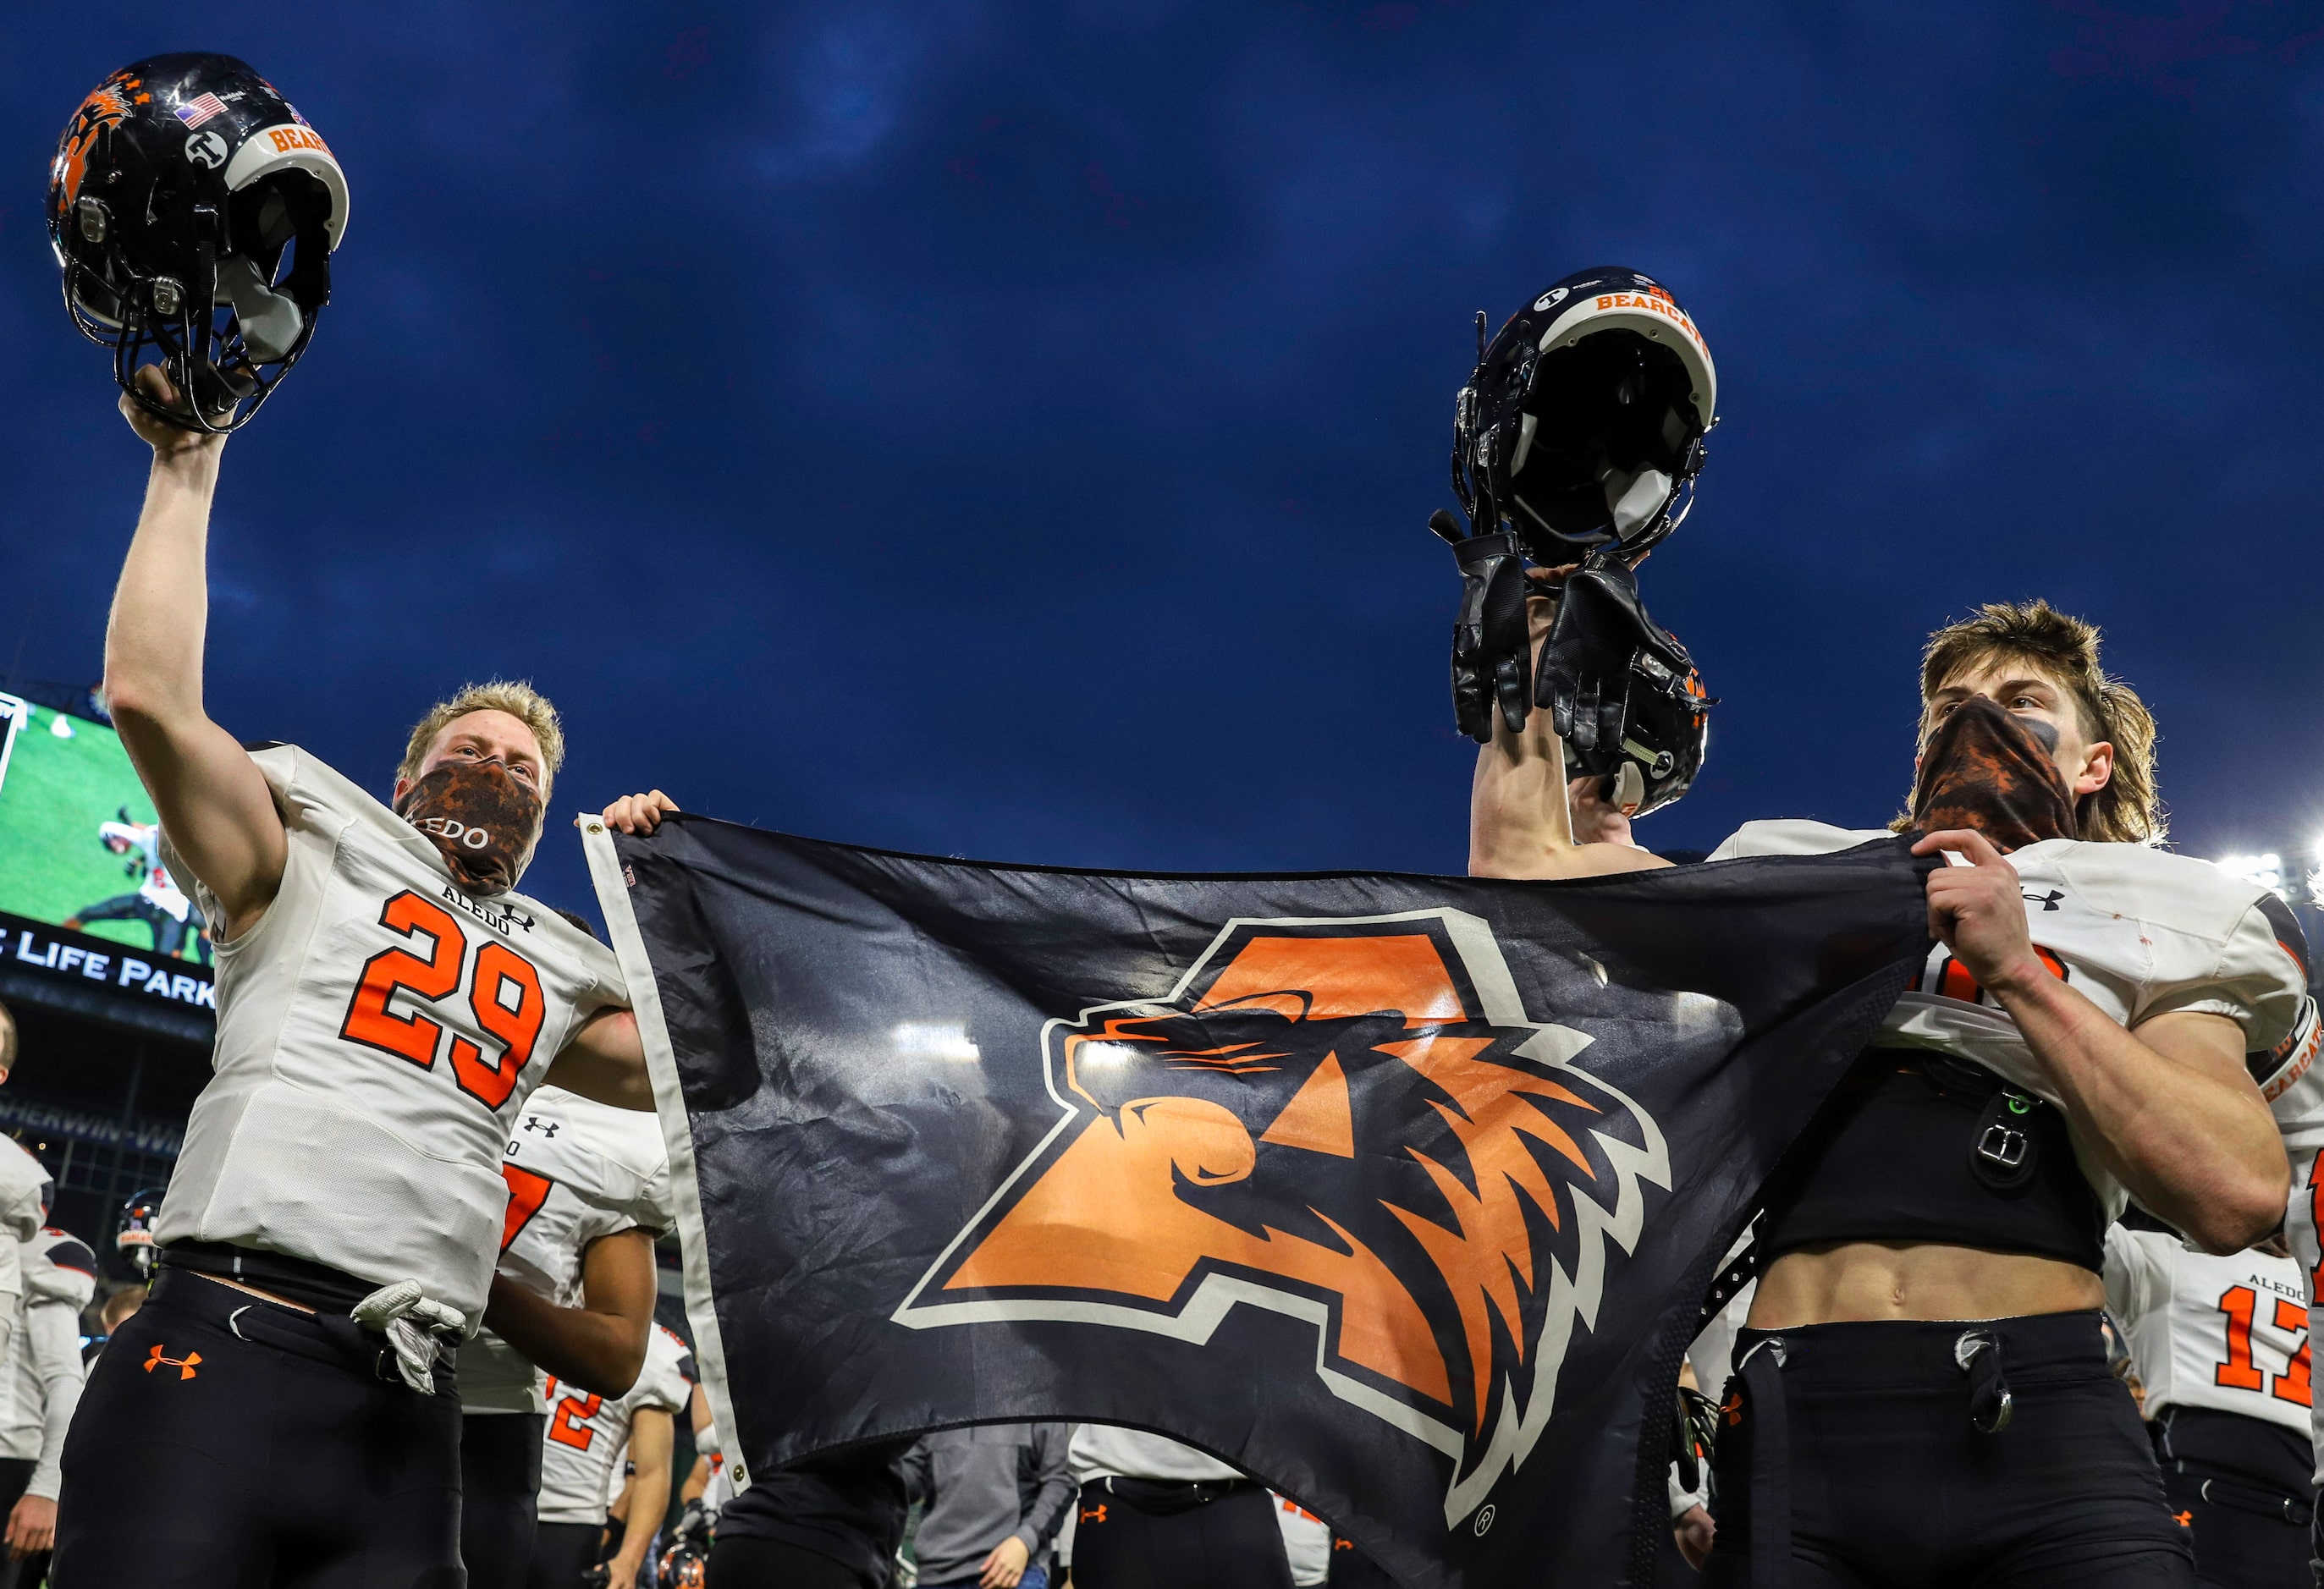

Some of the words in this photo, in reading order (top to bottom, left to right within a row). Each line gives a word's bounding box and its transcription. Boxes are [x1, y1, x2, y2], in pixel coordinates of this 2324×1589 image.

[188, 133, 223, 166] T
[1539, 289, 1562, 306] T
[1596, 294, 1709, 361] BEARCATS
[413, 814, 489, 849] EDO
[442, 885, 509, 936] ALEDO
[339, 888, 546, 1113] 29
[2262, 1019, 2322, 1103] EARCATS
